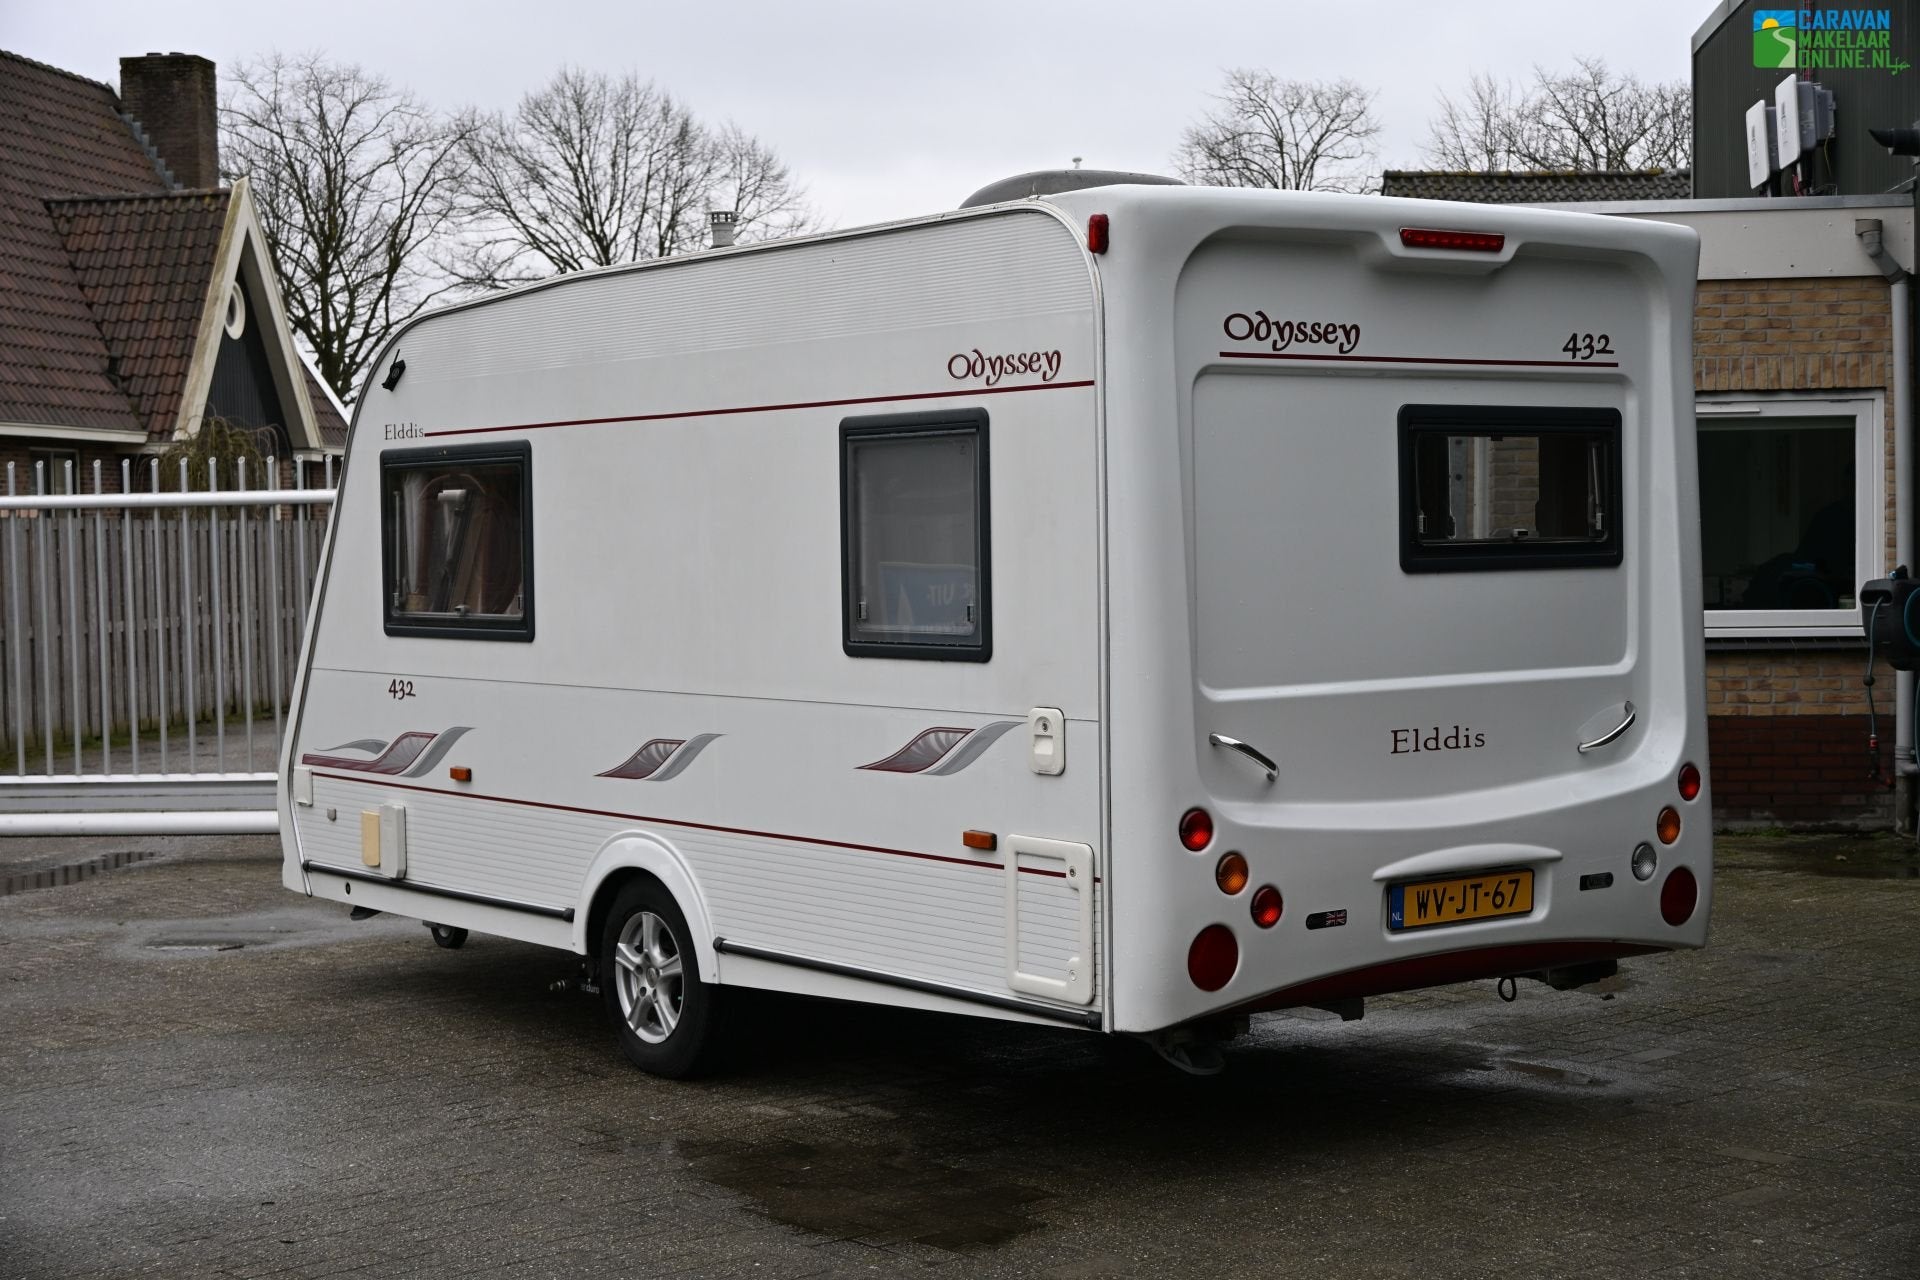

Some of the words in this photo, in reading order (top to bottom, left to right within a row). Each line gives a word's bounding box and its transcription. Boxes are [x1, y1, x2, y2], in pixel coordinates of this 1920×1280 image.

[1223, 310, 1361, 355] Odyssey
[1562, 332, 1615, 360] 432
[948, 347, 1062, 386] Odyssey
[384, 421, 424, 441] Elddis
[388, 678, 417, 700] 432
[1390, 725, 1486, 754] Elddis
[1416, 878, 1521, 919] WV-JT-67
[1391, 911, 1403, 921] NL
